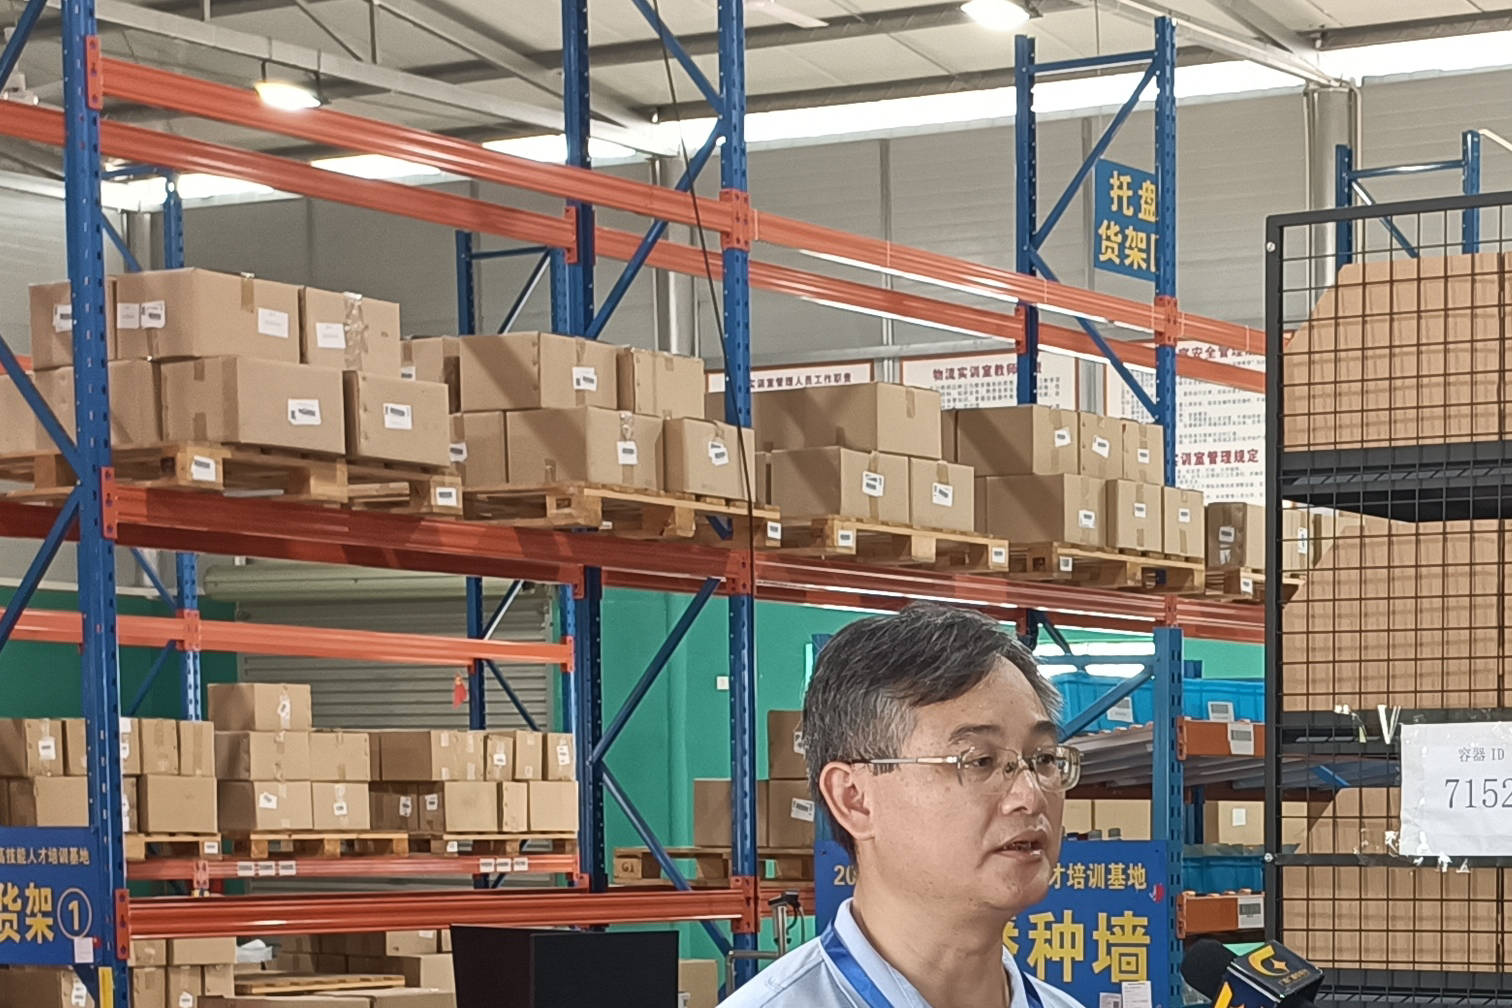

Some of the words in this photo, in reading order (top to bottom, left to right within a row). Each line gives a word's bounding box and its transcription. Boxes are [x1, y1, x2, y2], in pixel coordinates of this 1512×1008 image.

[1109, 170, 1157, 223] 托盘
[1175, 449, 1259, 467] 训室管理规定
[1458, 747, 1486, 762] 容器
[1491, 748, 1505, 761] ID
